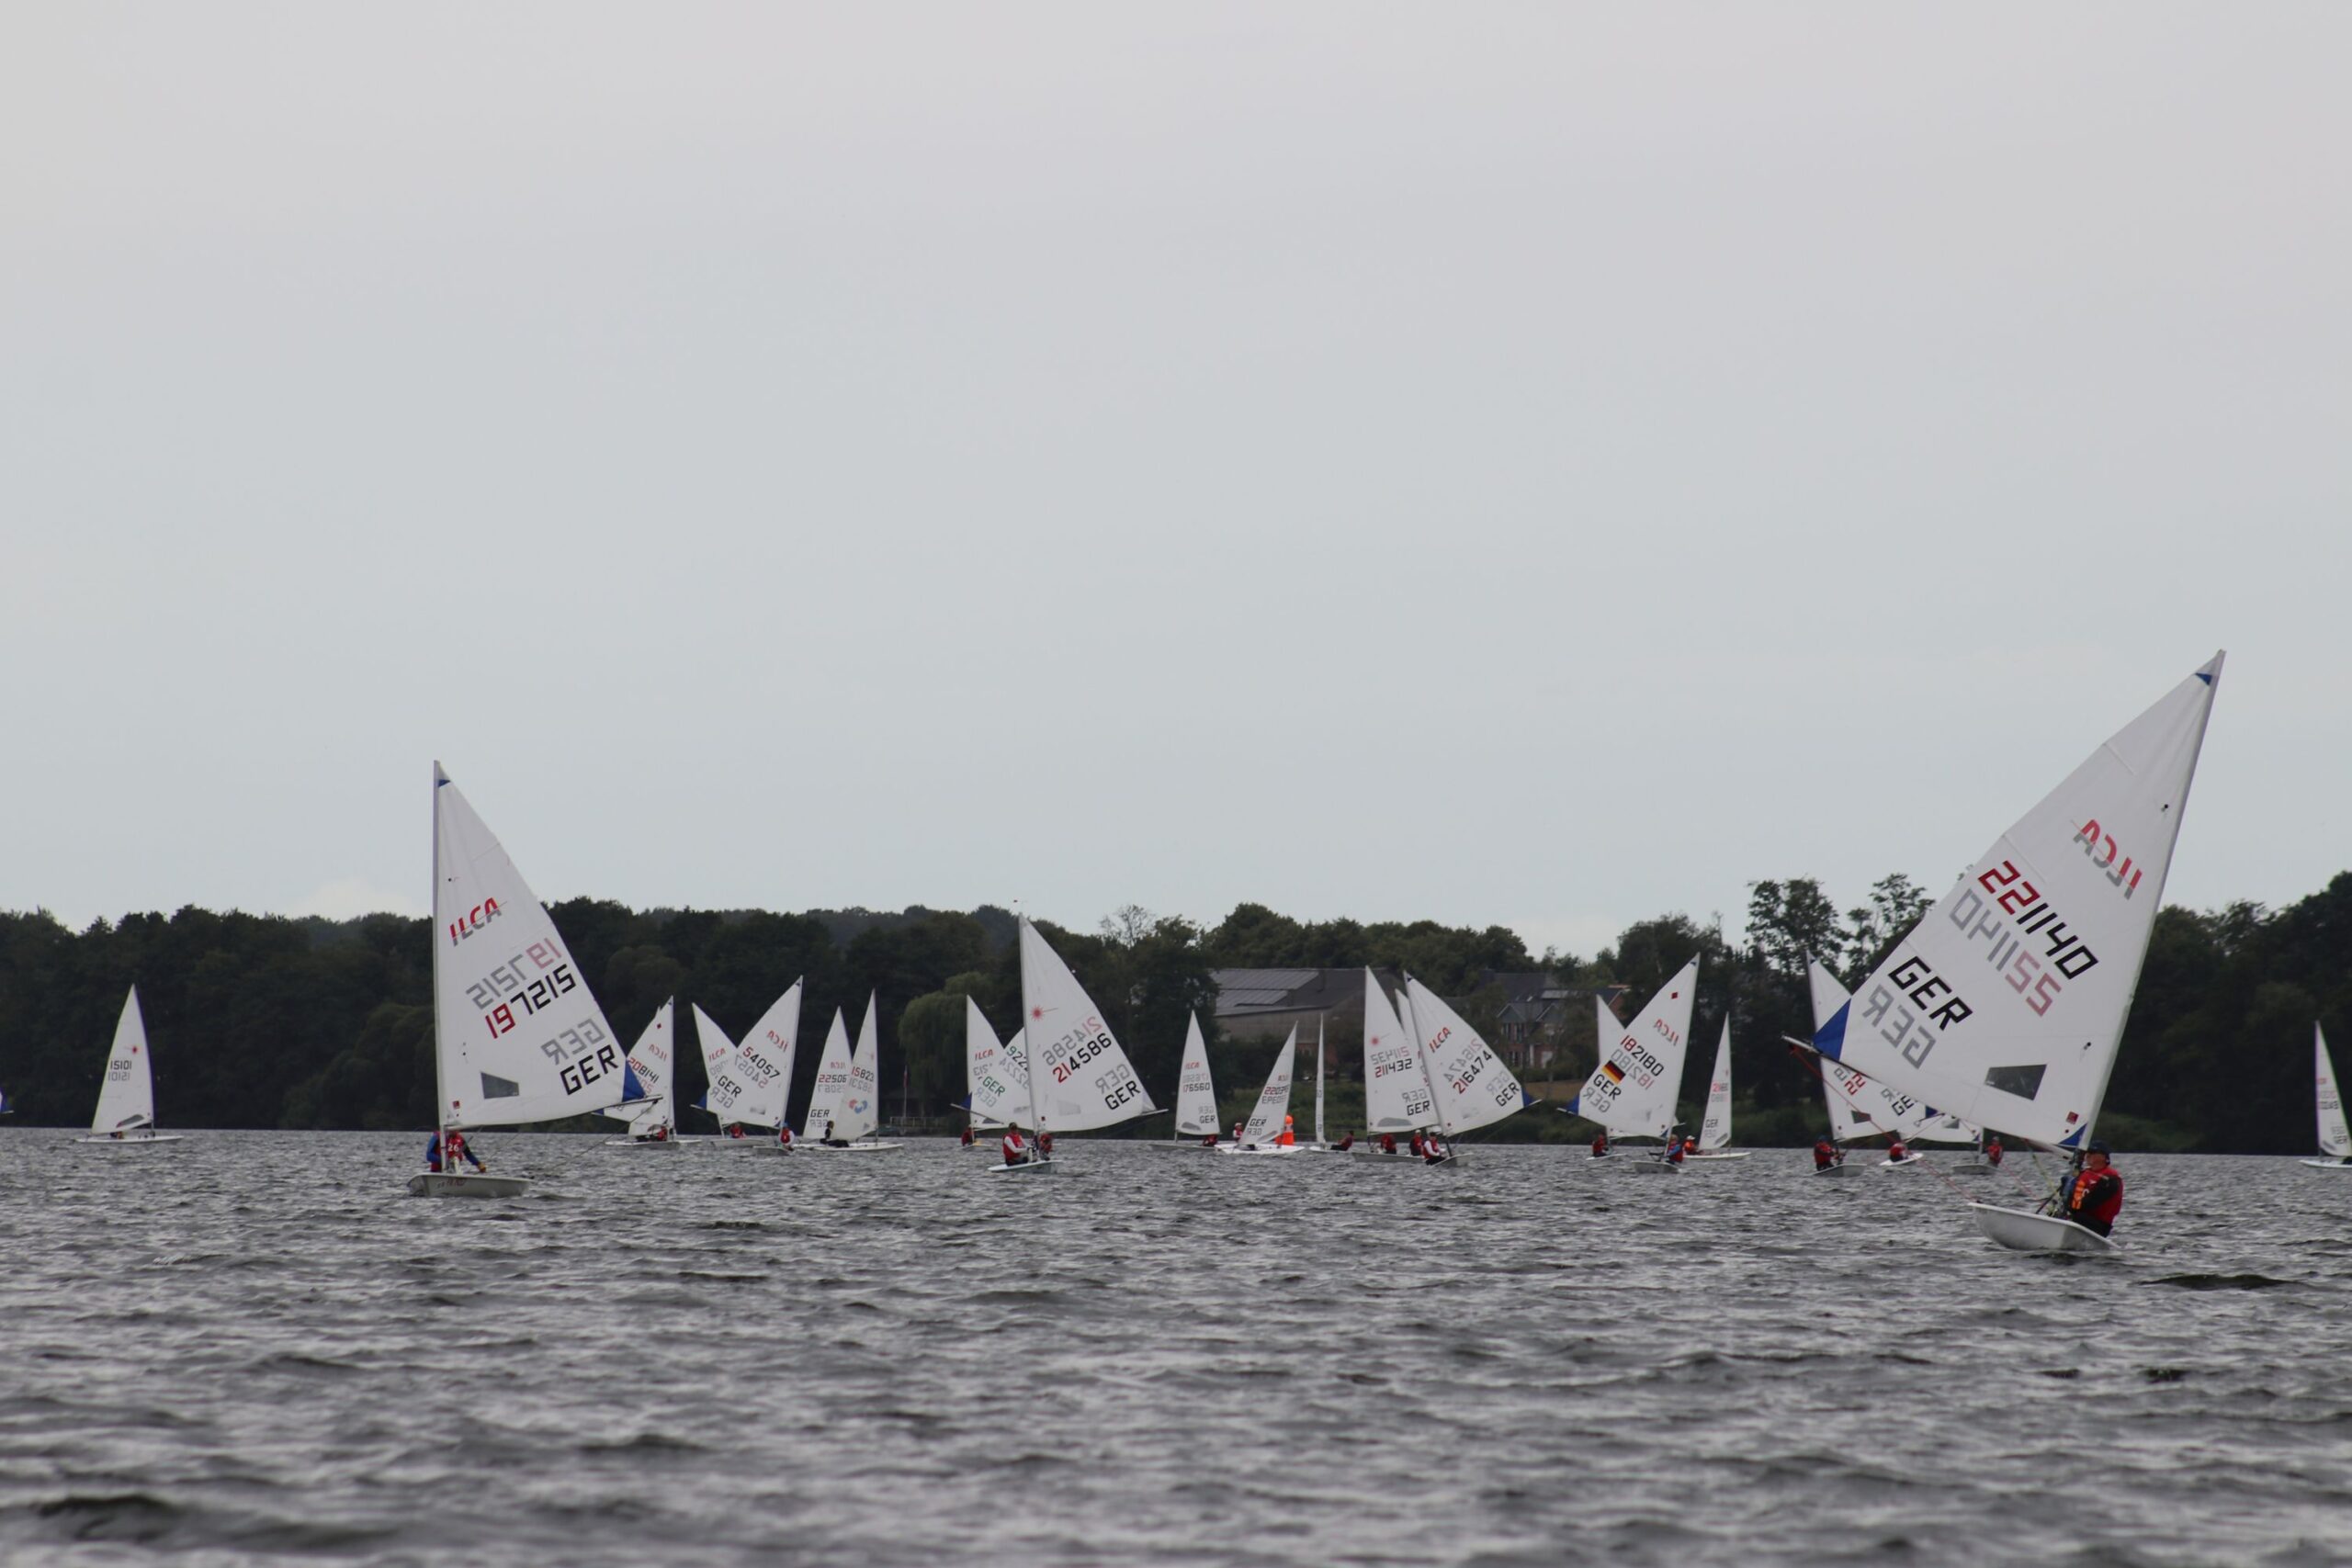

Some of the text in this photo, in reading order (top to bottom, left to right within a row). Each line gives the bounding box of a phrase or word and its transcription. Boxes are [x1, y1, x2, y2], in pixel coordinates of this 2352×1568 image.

[449, 897, 502, 947] ILCA
[1978, 860, 2098, 980] 221140
[485, 964, 576, 1039] 197215
[1888, 955, 1973, 1032] GER
[1429, 1026, 1452, 1054] ILCA
[110, 1060, 132, 1070] 15101
[708, 1047, 726, 1062] ILCA
[742, 1046, 781, 1078] 54057
[975, 1049, 994, 1061] ILCA
[1052, 1032, 1112, 1084] 214586
[1620, 1034, 1665, 1077] 182180
[560, 1044, 618, 1095] GER
[1374, 1058, 1412, 1078] 211432
[1453, 1050, 1492, 1095] 216474
[718, 1076, 742, 1098] GER
[982, 1076, 1006, 1098] GER
[1104, 1080, 1141, 1111] GER
[1496, 1081, 1520, 1107] GER
[1593, 1074, 1622, 1100] GER
[810, 1109, 830, 1118] GER
[1407, 1100, 1430, 1116] GER
[1891, 1095, 1918, 1117] GE
[448, 1144, 459, 1152] 26
